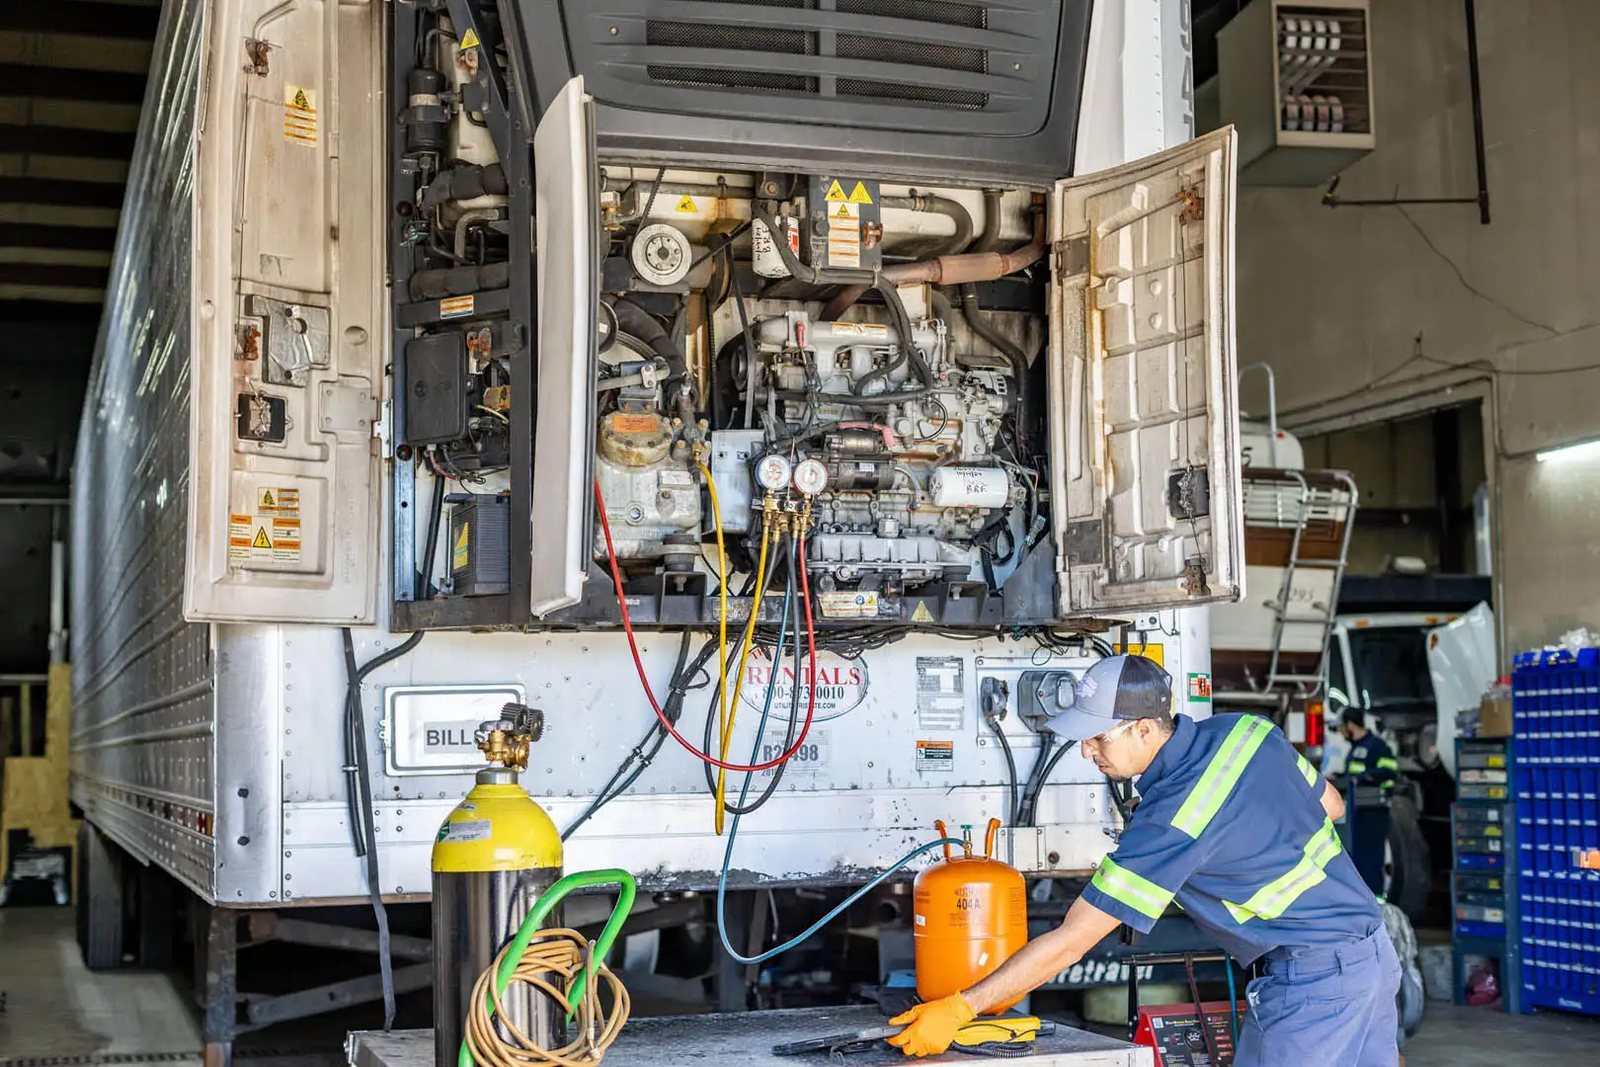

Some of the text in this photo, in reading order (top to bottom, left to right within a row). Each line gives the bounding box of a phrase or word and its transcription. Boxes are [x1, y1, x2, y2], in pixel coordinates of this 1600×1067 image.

[748, 667, 861, 686] RENTALS
[762, 686, 844, 699] 80-8730010
[763, 744, 819, 762] R2498
[956, 898, 981, 910] 404A
